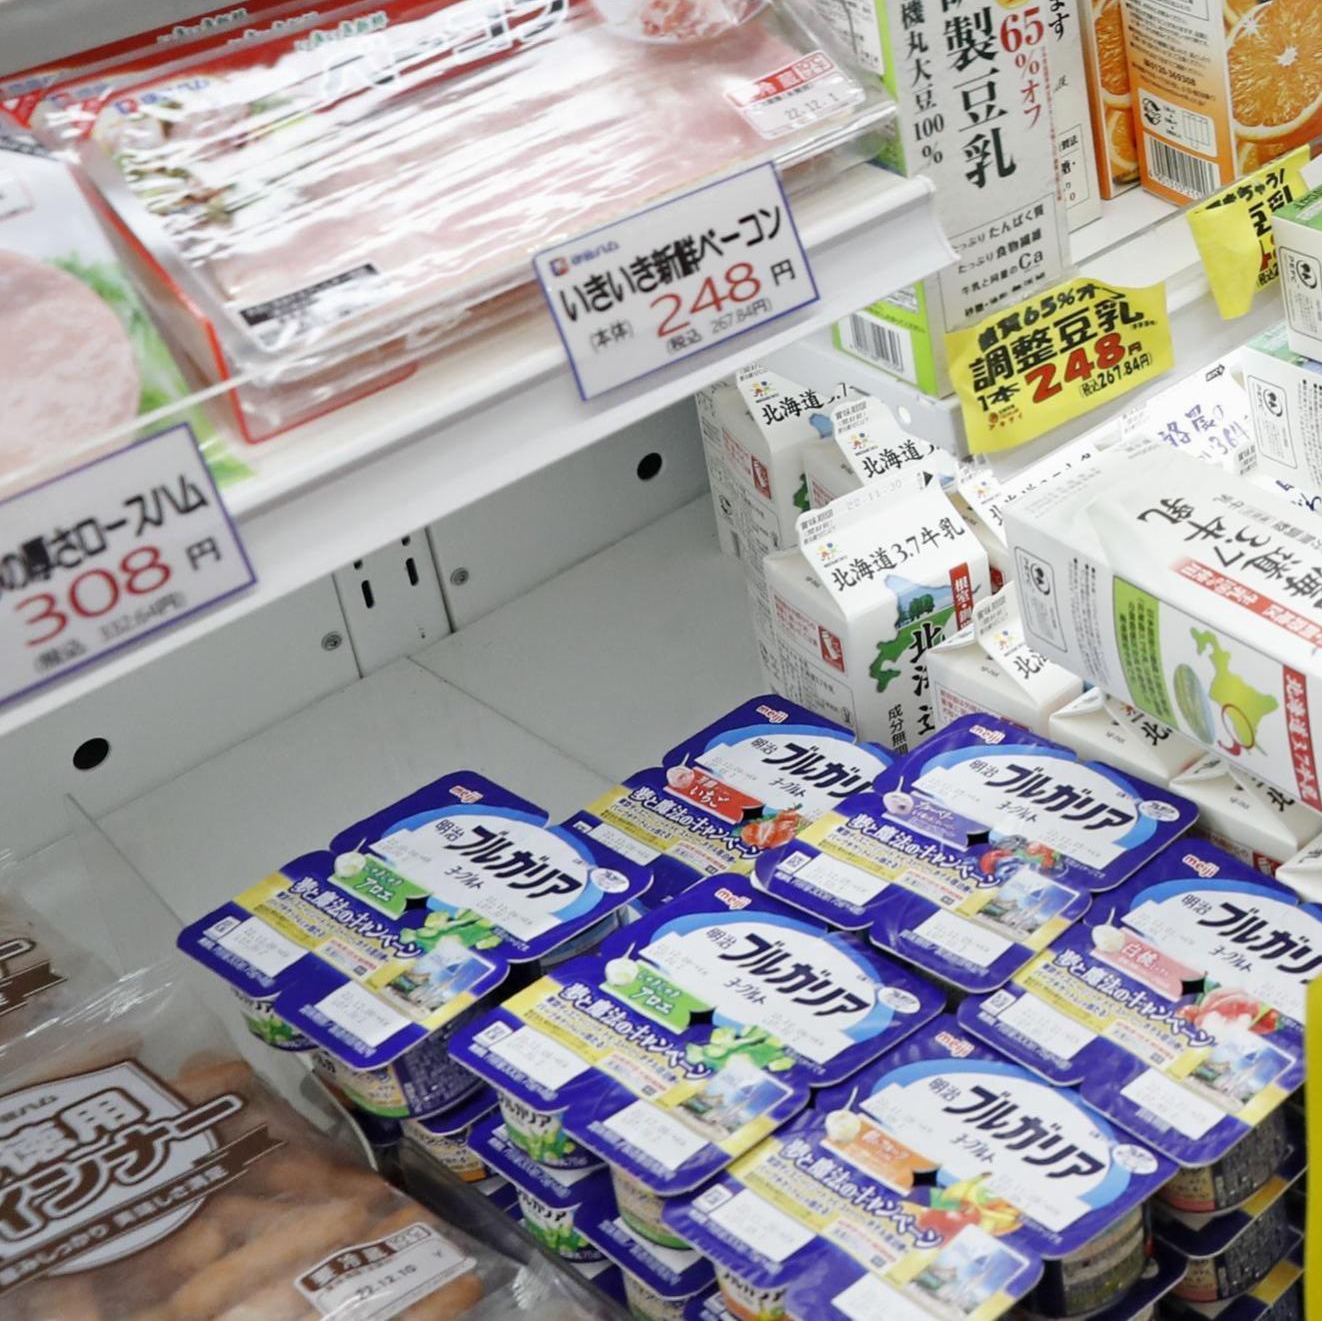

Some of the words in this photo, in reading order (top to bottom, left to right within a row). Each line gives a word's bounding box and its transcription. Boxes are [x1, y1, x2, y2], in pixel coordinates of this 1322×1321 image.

[560, 205, 783, 325] いきいき新鮮ベーコン
[649, 261, 762, 338] 248
[771, 260, 796, 288] 円
[15, 543, 174, 648] 308
[186, 536, 221, 571] 円
[830, 516, 967, 593] 北海道3.7牛乳
[755, 704, 789, 725] meiji
[435, 818, 463, 846] 明治
[1000, 761, 1134, 834] ブルガリア
[444, 825, 583, 900] ブルガリア
[720, 930, 871, 1020] ブルガリア
[944, 1084, 1105, 1179] ブルガリア
